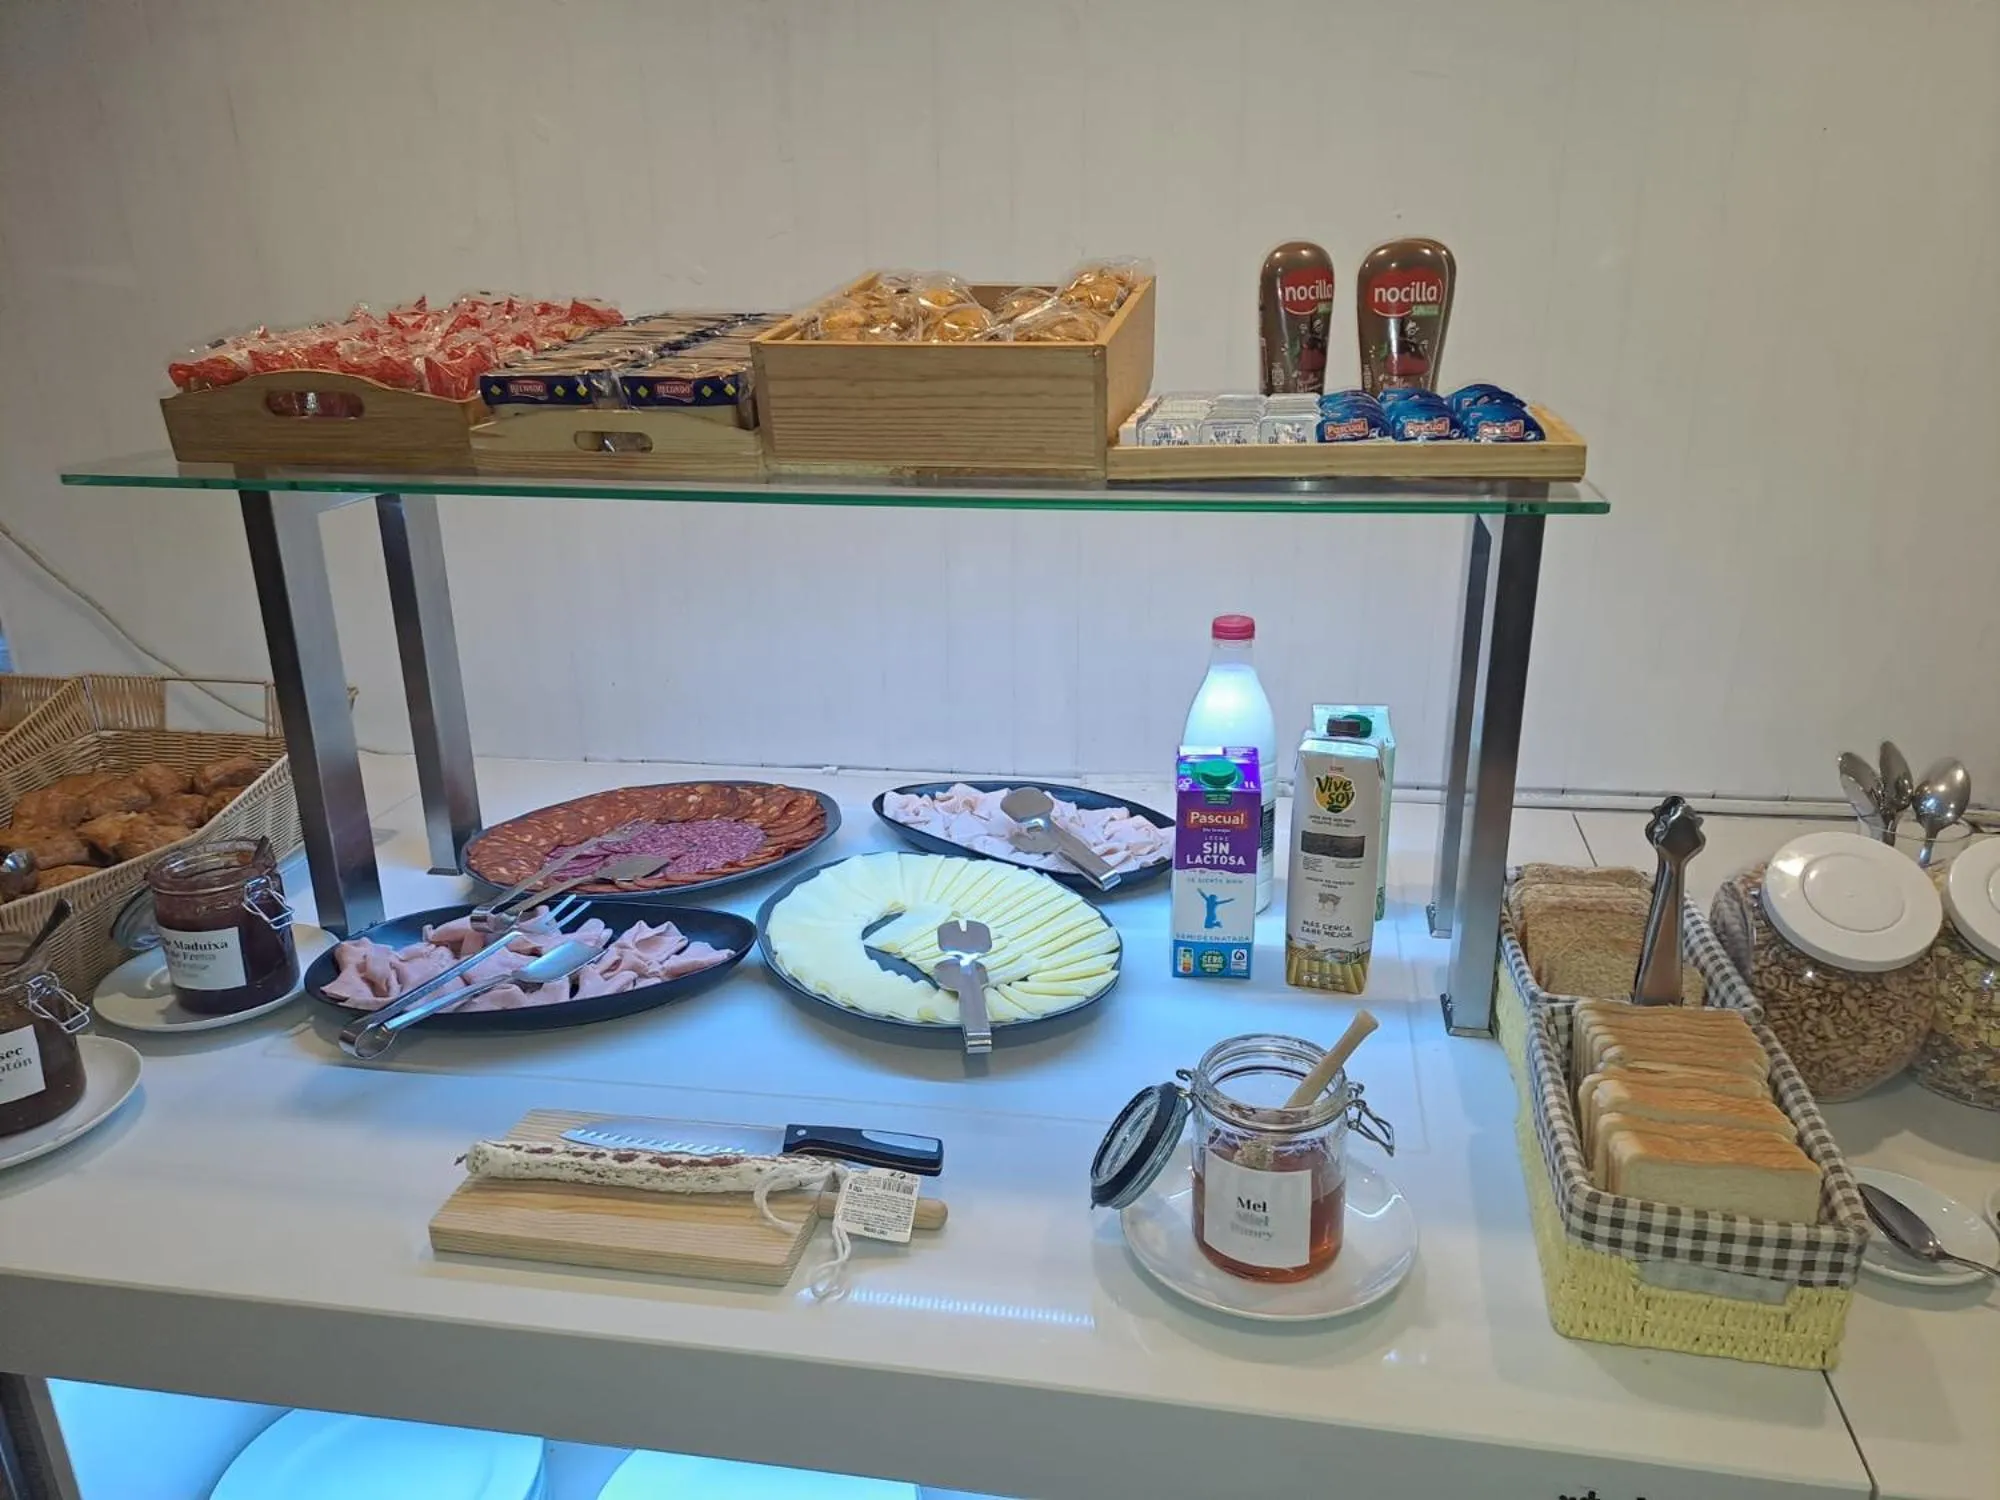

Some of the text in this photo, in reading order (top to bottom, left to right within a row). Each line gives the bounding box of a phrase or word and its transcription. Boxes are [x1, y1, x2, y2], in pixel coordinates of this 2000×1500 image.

[1284, 279, 1333, 302] nocilla
[1374, 281, 1438, 303] nocilla
[1326, 422, 1366, 435] Pascual
[1405, 420, 1446, 435] Pascual
[1315, 775, 1353, 794] Vive
[1190, 811, 1245, 825] Pascual
[1202, 842, 1230, 855] SIN
[1186, 854, 1247, 866] LACTOSA
[173, 939, 229, 951] Maduixa
[1237, 1196, 1268, 1212] Mel
